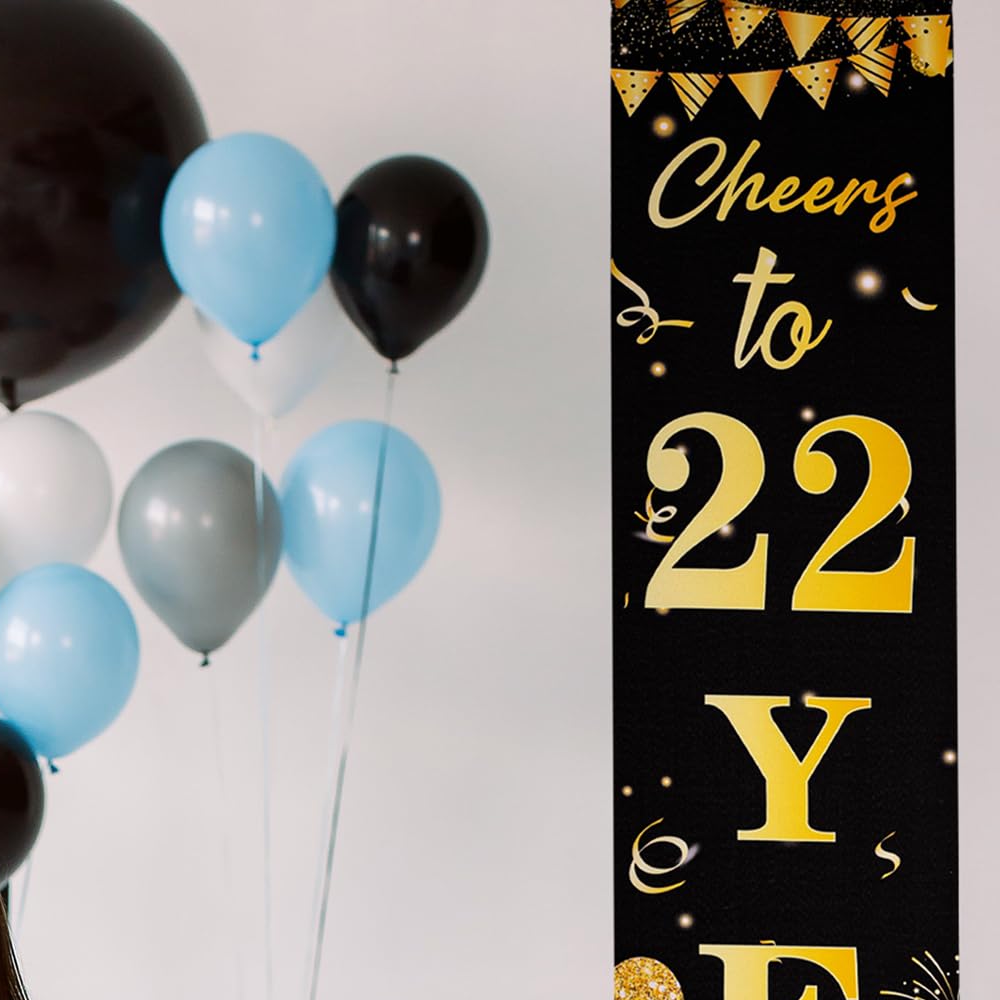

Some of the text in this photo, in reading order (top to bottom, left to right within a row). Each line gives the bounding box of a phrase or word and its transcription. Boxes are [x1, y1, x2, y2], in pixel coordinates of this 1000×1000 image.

[647, 136, 918, 234] Cheers
[732, 246, 833, 370] to
[644, 411, 916, 613] 22
